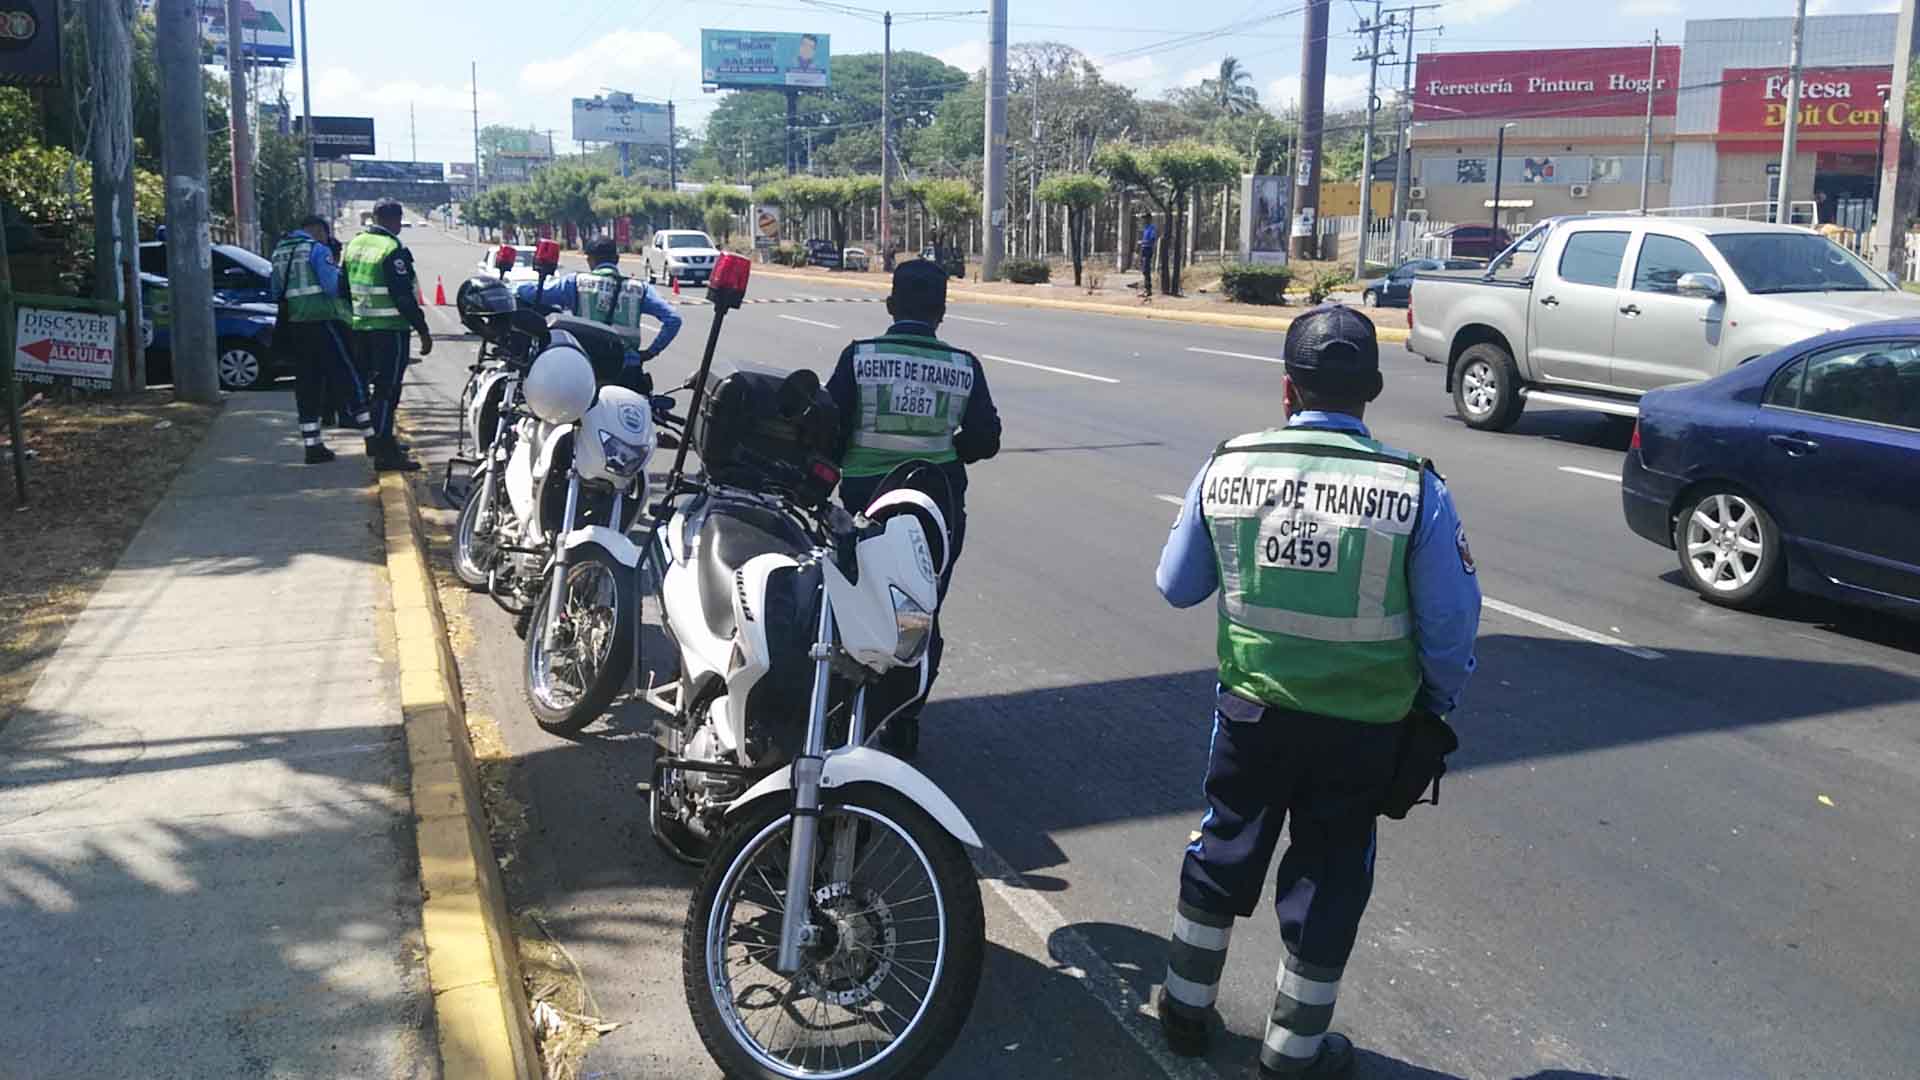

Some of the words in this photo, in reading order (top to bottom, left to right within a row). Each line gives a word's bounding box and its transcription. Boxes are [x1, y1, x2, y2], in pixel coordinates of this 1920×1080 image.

[1429, 78, 1513, 96] Ferretería
[1527, 76, 1595, 93] Pintura
[49, 345, 112, 363] ALQUILA
[856, 359, 901, 378] AGENTE
[904, 360, 919, 380] DE
[921, 364, 972, 390] TRANSITO
[903, 384, 926, 397] CHIP
[895, 396, 932, 415] 12887
[1206, 476, 1277, 507] AGENTE
[1280, 479, 1308, 509] DE
[1314, 483, 1412, 523] TRANSITO
[1280, 519, 1318, 538] CHIP
[1265, 535, 1332, 568] 0459
